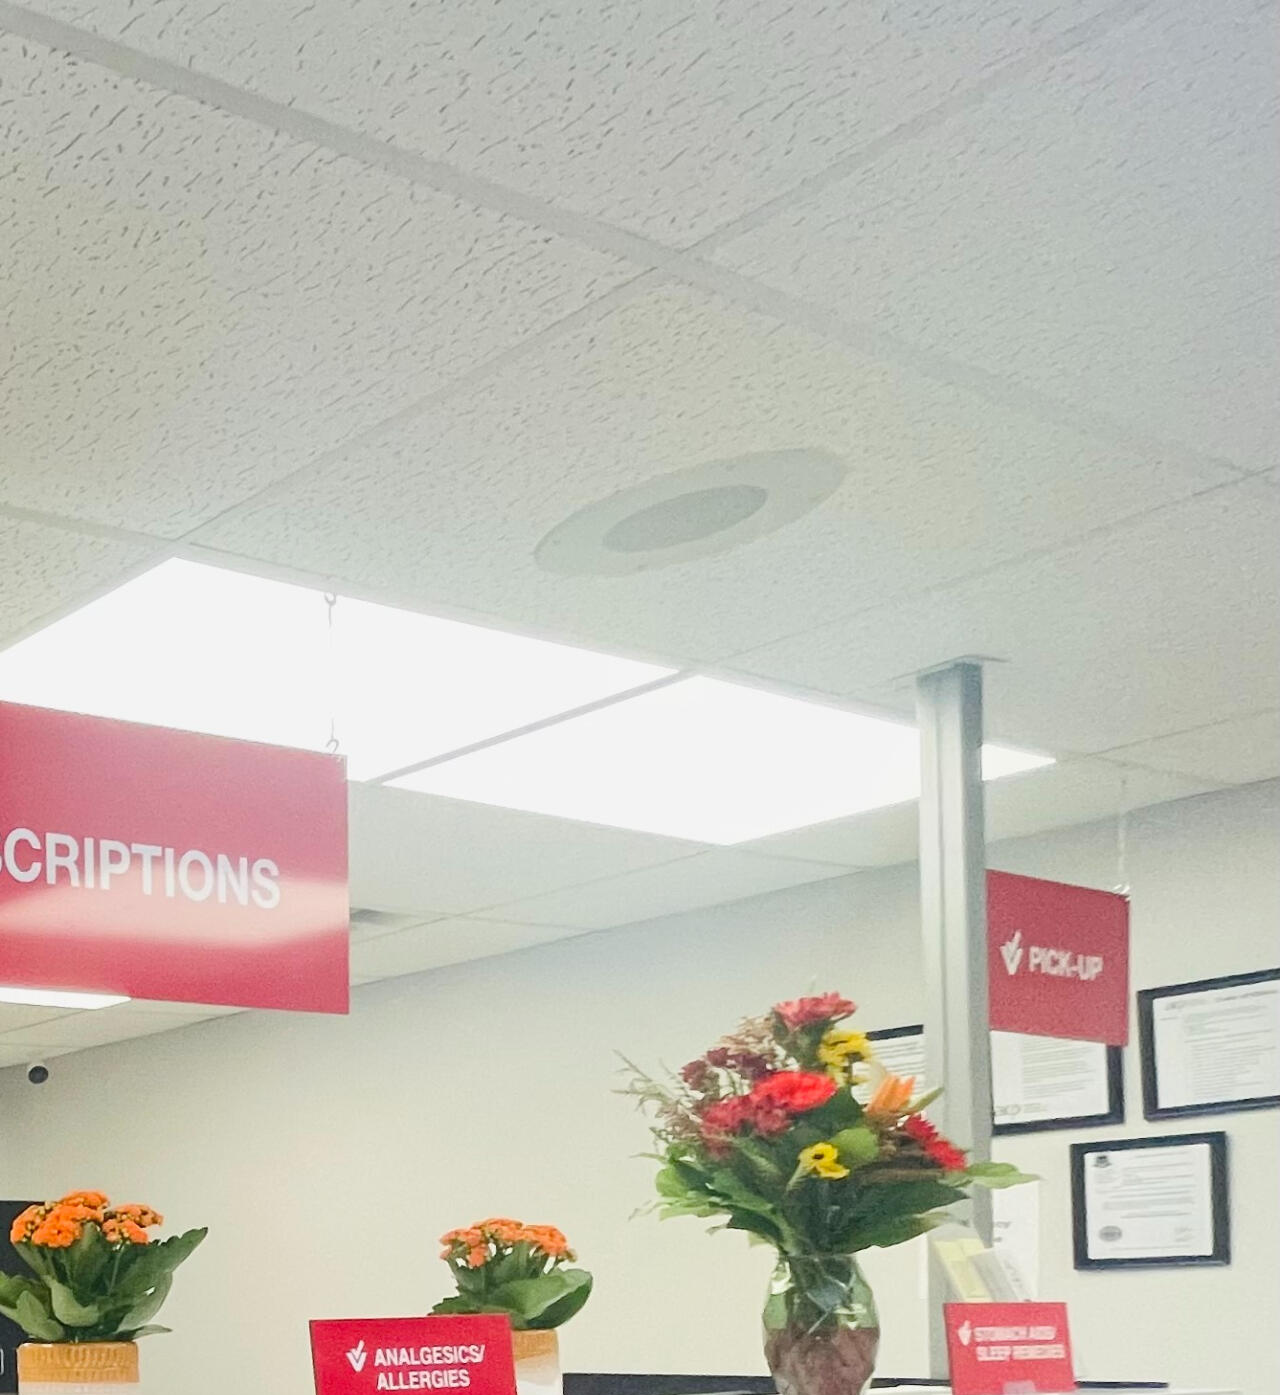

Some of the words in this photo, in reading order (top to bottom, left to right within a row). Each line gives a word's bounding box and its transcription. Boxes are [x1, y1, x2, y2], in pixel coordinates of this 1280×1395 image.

[1029, 946, 1104, 980] PICK-UP
[374, 1344, 485, 1366] ANALGESICS/
[377, 1370, 470, 1391] ALLERGIES
